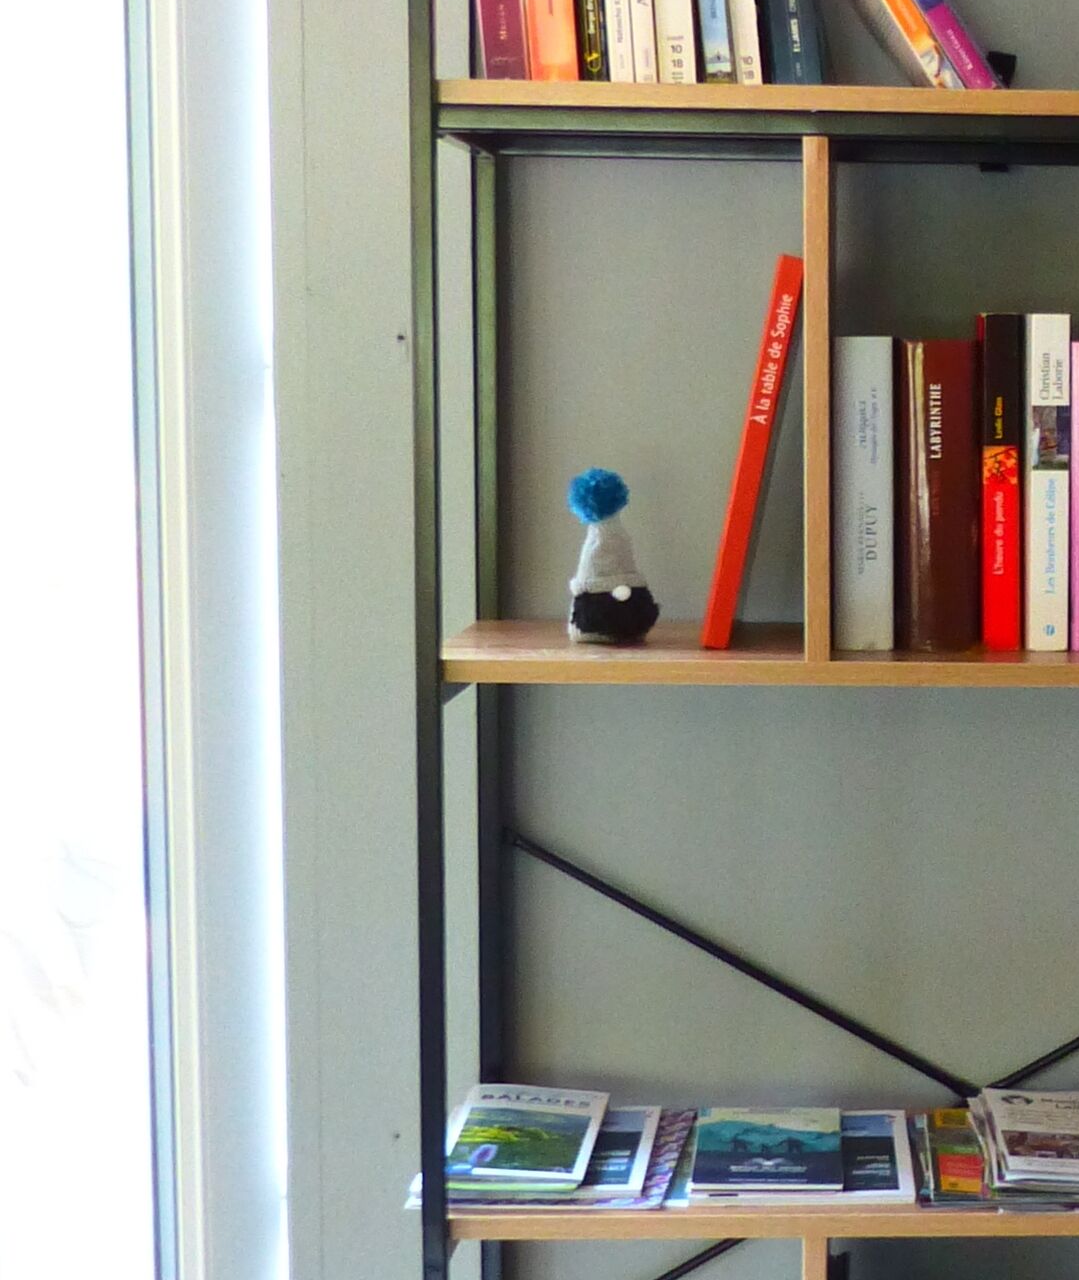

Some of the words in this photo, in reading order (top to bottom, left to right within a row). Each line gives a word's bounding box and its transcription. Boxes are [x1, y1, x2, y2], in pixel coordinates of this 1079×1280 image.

[671, 45, 683, 54] 10
[671, 58, 684, 68] 18
[741, 56, 754, 65] 10
[771, 294, 793, 338] Sophie
[768, 342, 783, 359] de
[759, 362, 777, 394] table
[1040, 353, 1051, 400] Christian
[1053, 360, 1063, 399] Laborie
[750, 415, 767, 424] À
[754, 399, 771, 411] la
[930, 384, 942, 459] LABYRINTHE
[993, 492, 1006, 522] pendu
[1044, 479, 1056, 509] Céline
[866, 505, 878, 561] DUPUY
[993, 525, 1004, 536] du
[1045, 512, 1055, 524] de
[993, 539, 1004, 575] L'heure
[1044, 528, 1055, 574] Bonheurs
[1045, 578, 1055, 594] Les
